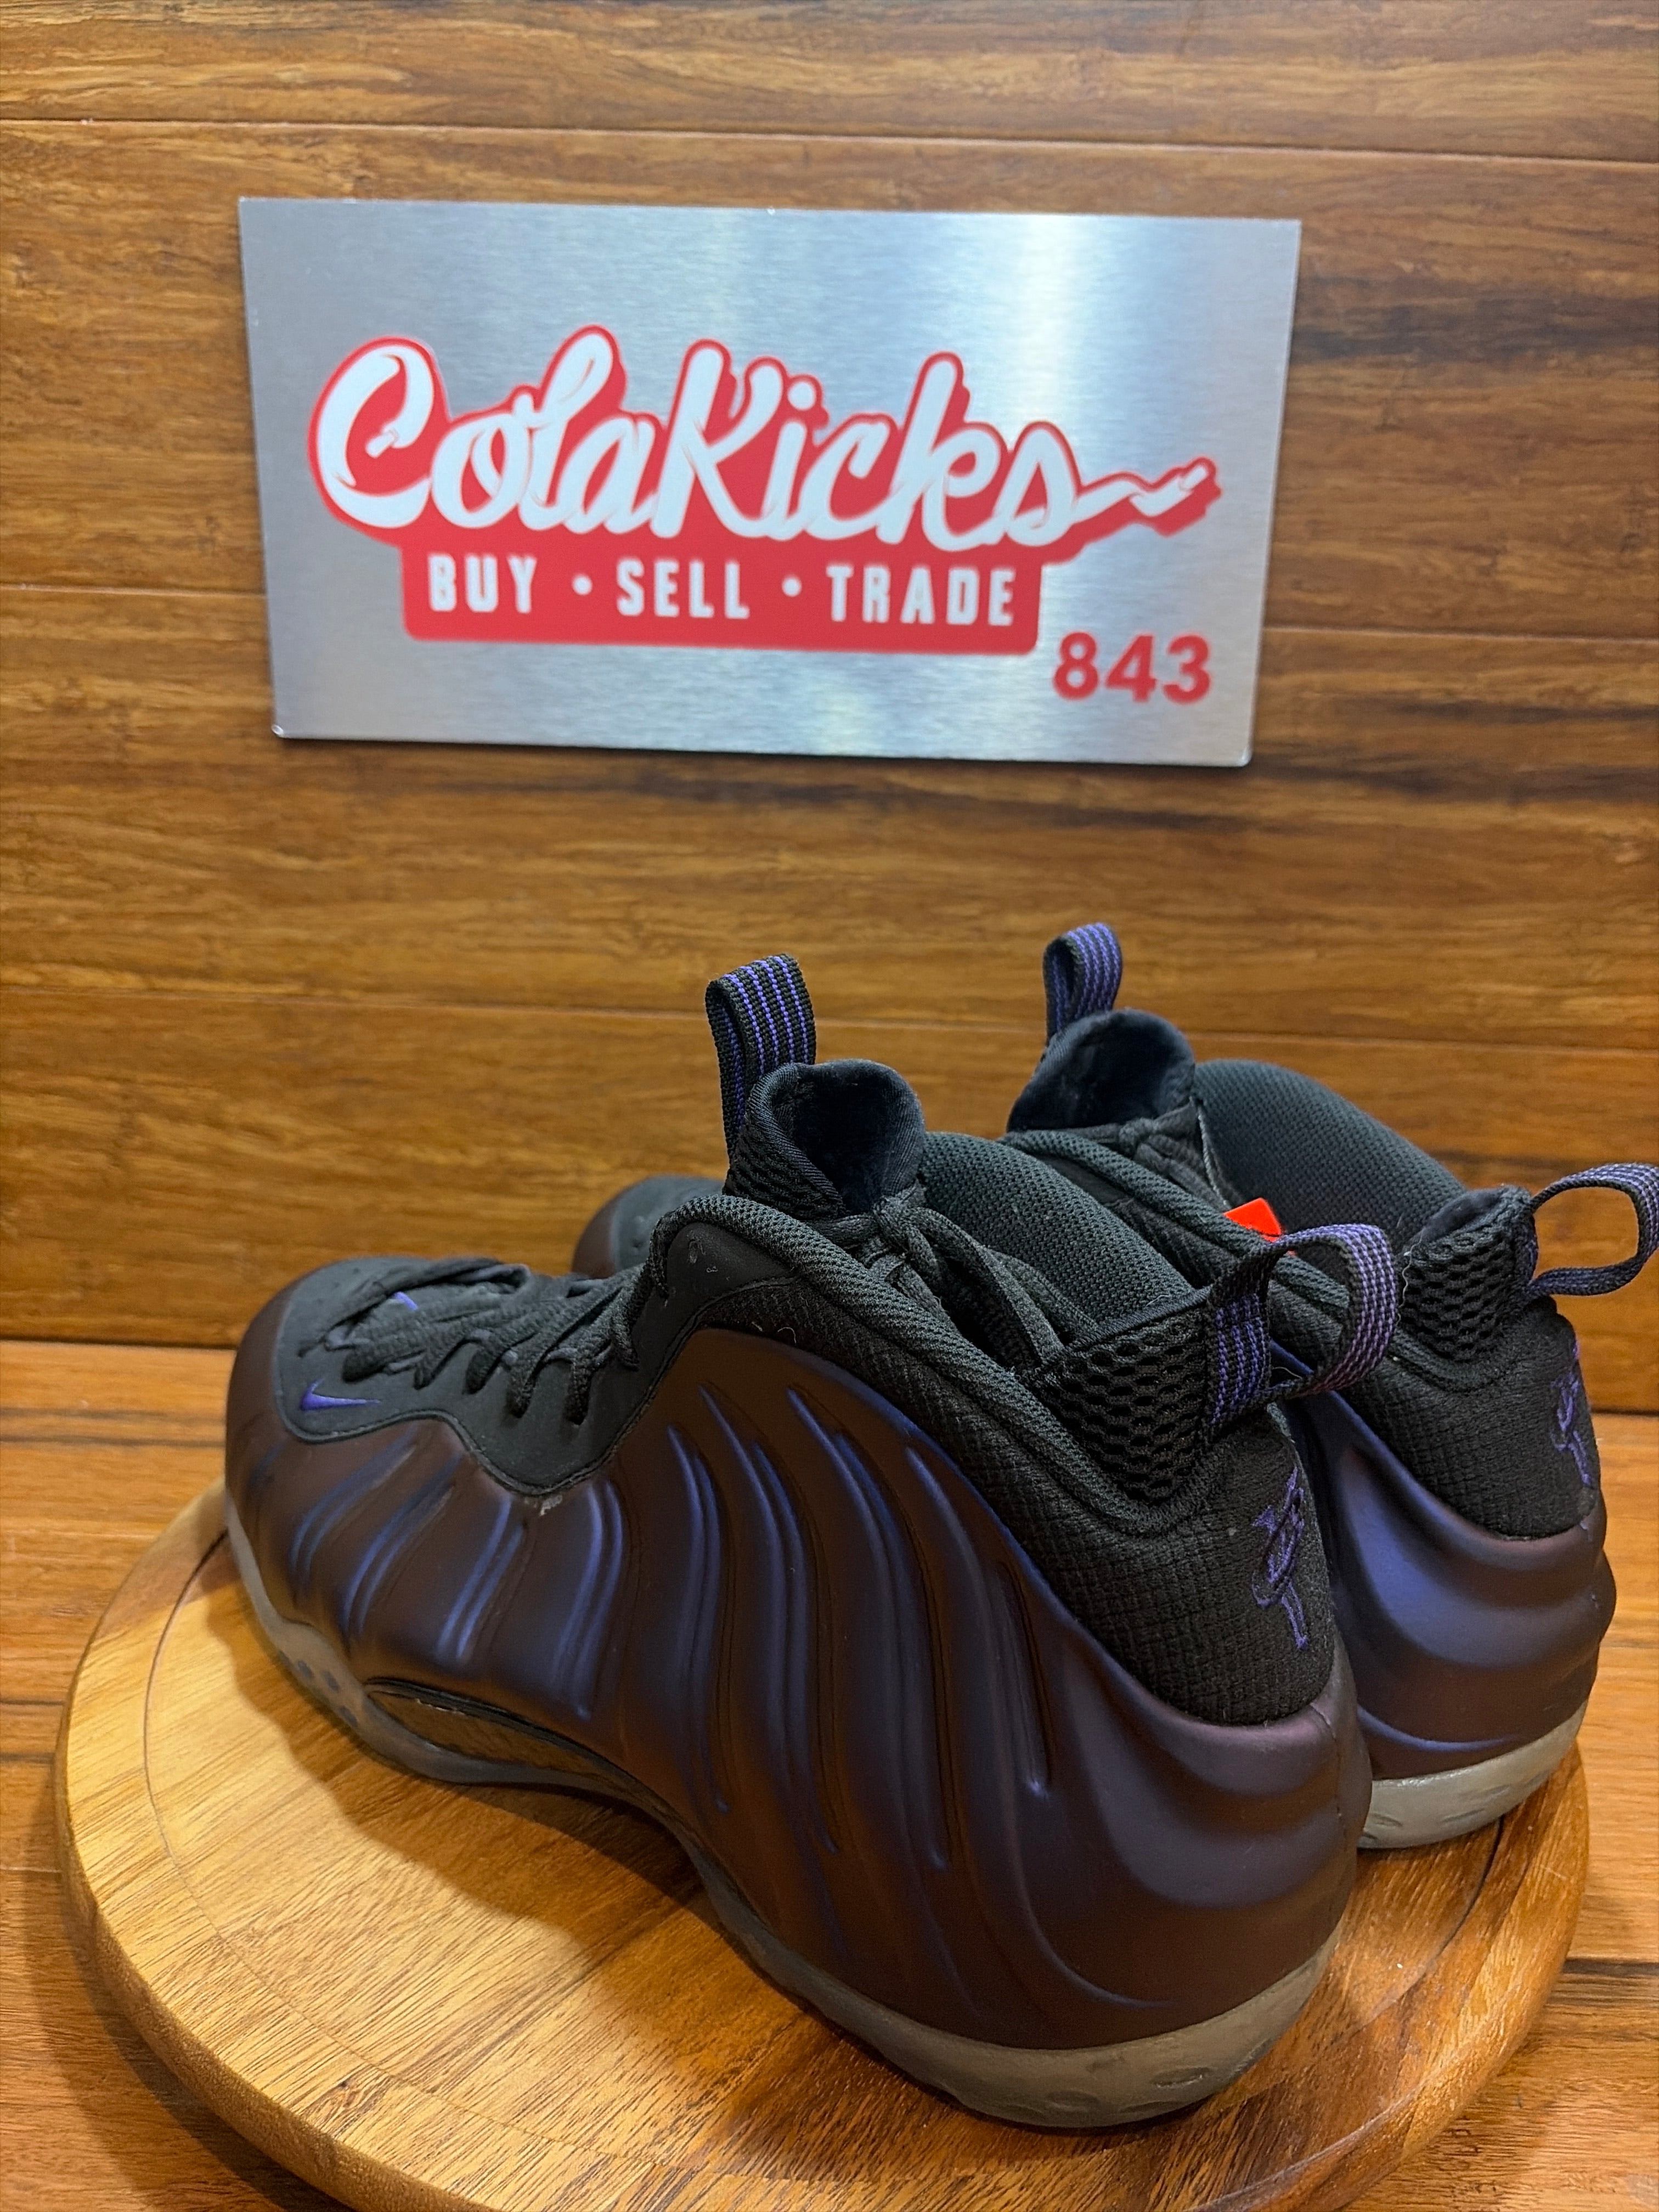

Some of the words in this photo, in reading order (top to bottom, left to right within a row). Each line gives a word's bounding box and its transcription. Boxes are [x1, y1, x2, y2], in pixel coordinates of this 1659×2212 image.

[314, 328, 1211, 550] ColaKicks
[428, 554, 536, 613] BUY
[617, 559, 749, 619] SELL
[826, 565, 1015, 625] TRADE
[1053, 632, 1211, 703] 843
